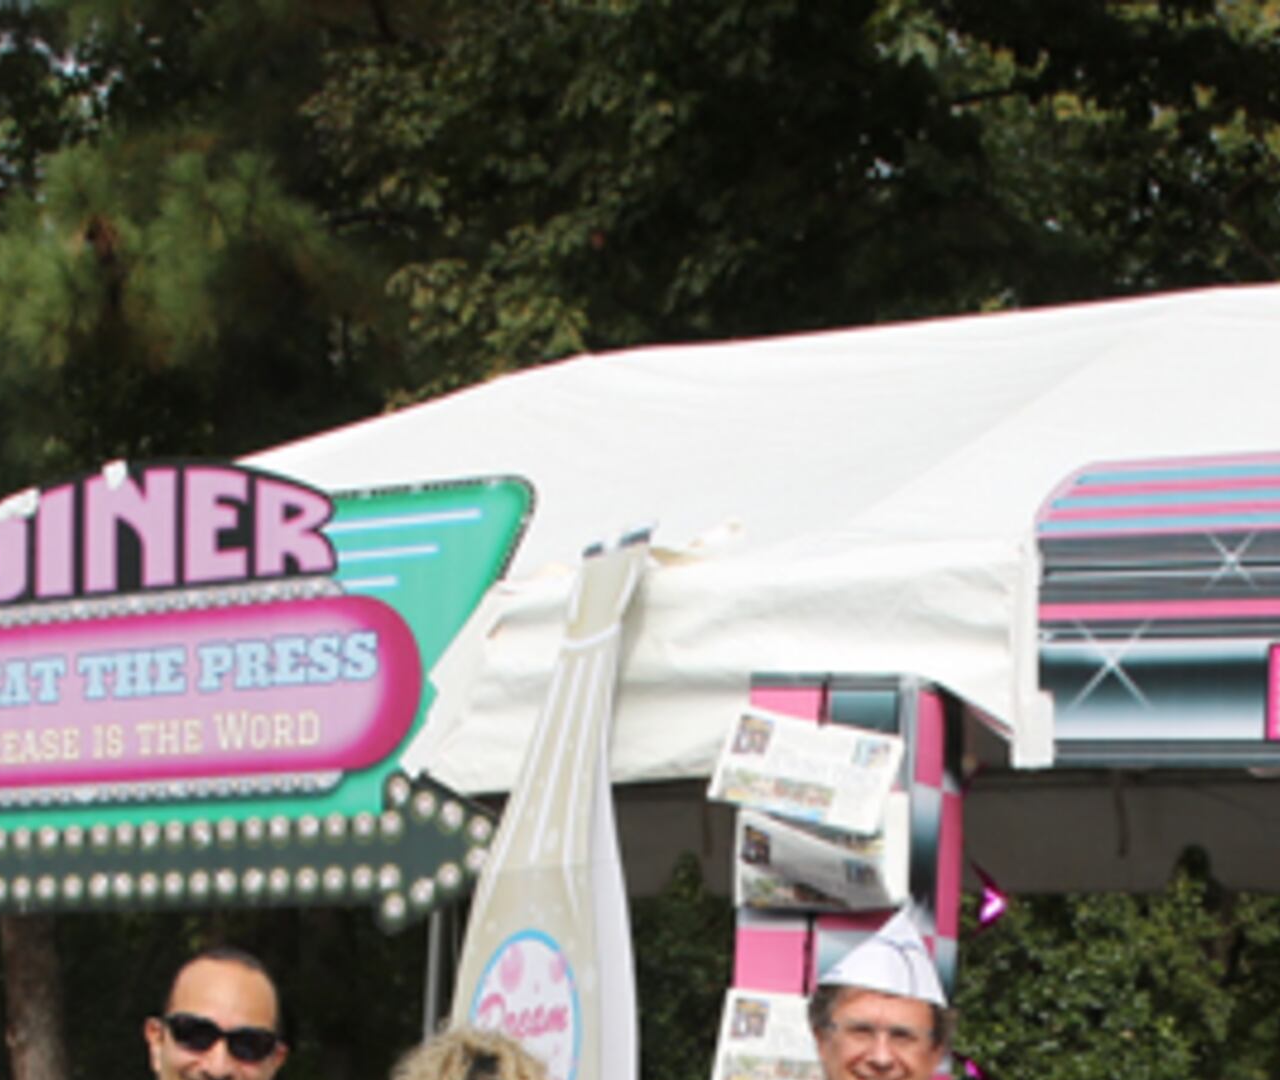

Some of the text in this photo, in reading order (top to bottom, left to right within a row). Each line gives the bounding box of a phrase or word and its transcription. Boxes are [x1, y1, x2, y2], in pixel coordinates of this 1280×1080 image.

[78, 646, 188, 701] THE
[196, 631, 379, 691] PRESS
[214, 709, 321, 749] WORD
